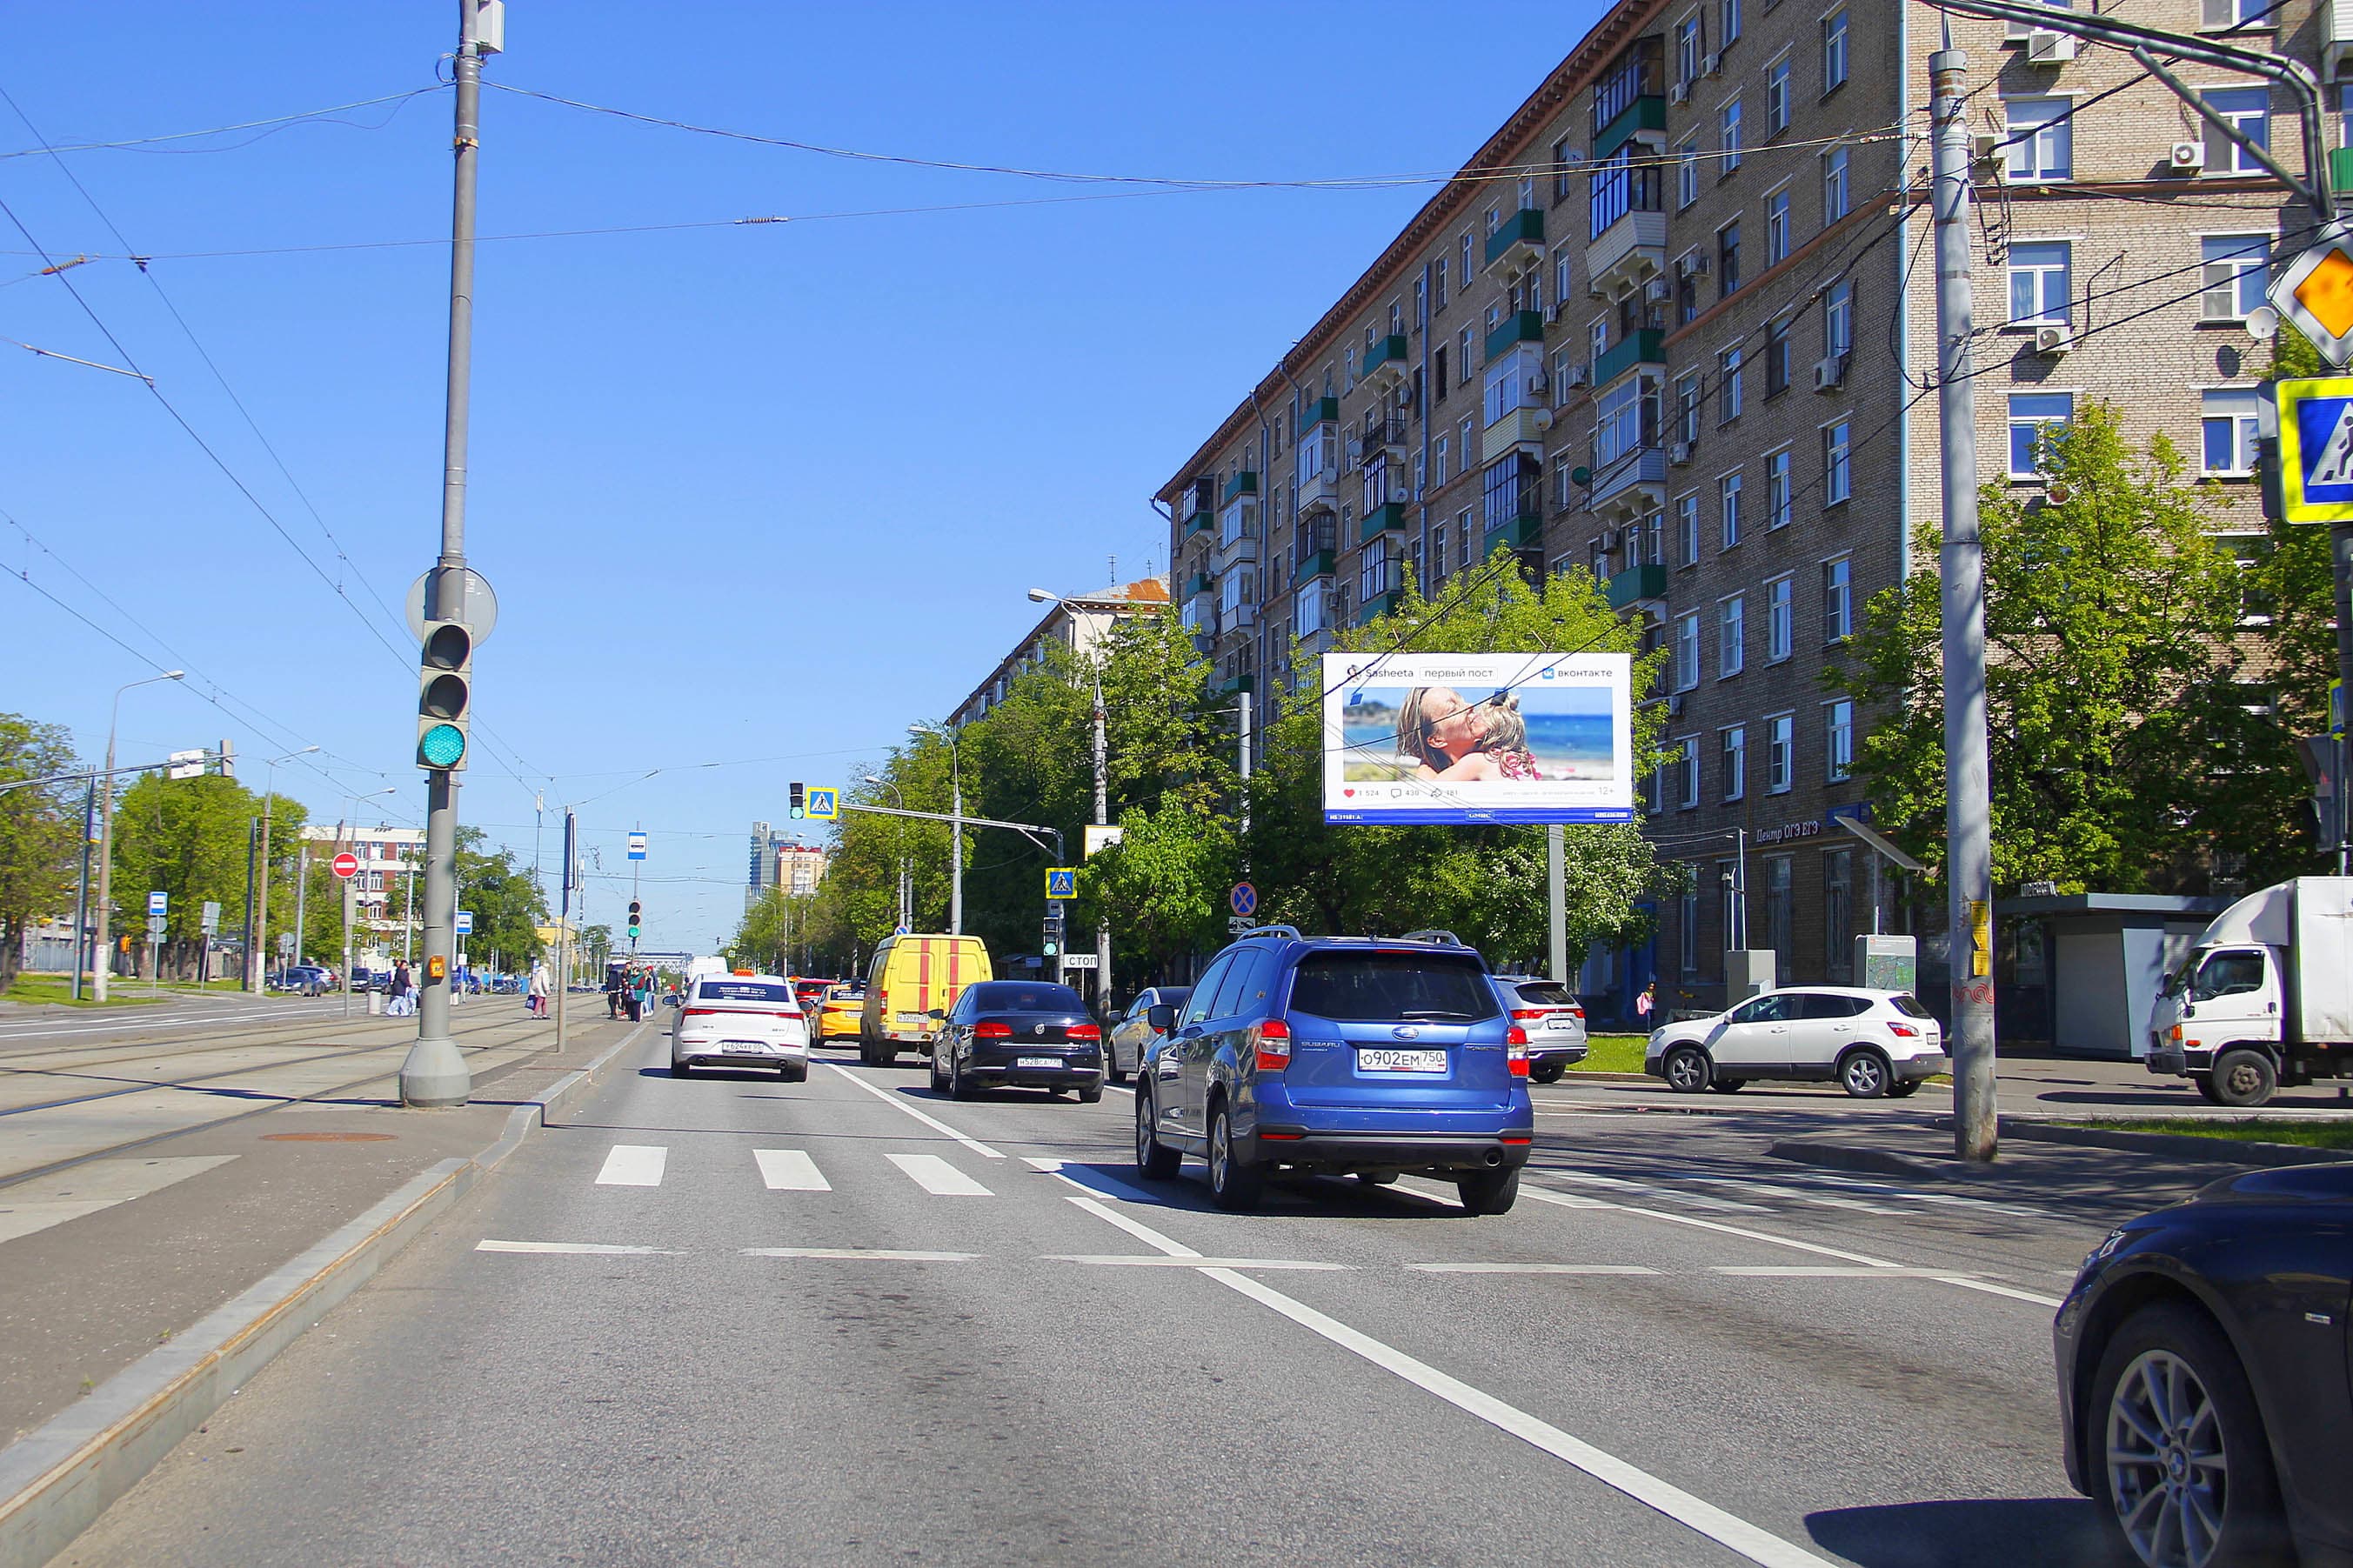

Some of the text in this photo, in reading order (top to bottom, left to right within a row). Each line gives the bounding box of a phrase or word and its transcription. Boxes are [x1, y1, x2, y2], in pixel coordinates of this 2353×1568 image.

[1366, 669, 1414, 677] Sasheeta
[1425, 668, 1465, 680] первый
[1756, 820, 1818, 844] Центр ОГЭ ЕГЭ
[1069, 957, 1097, 965] СТОП
